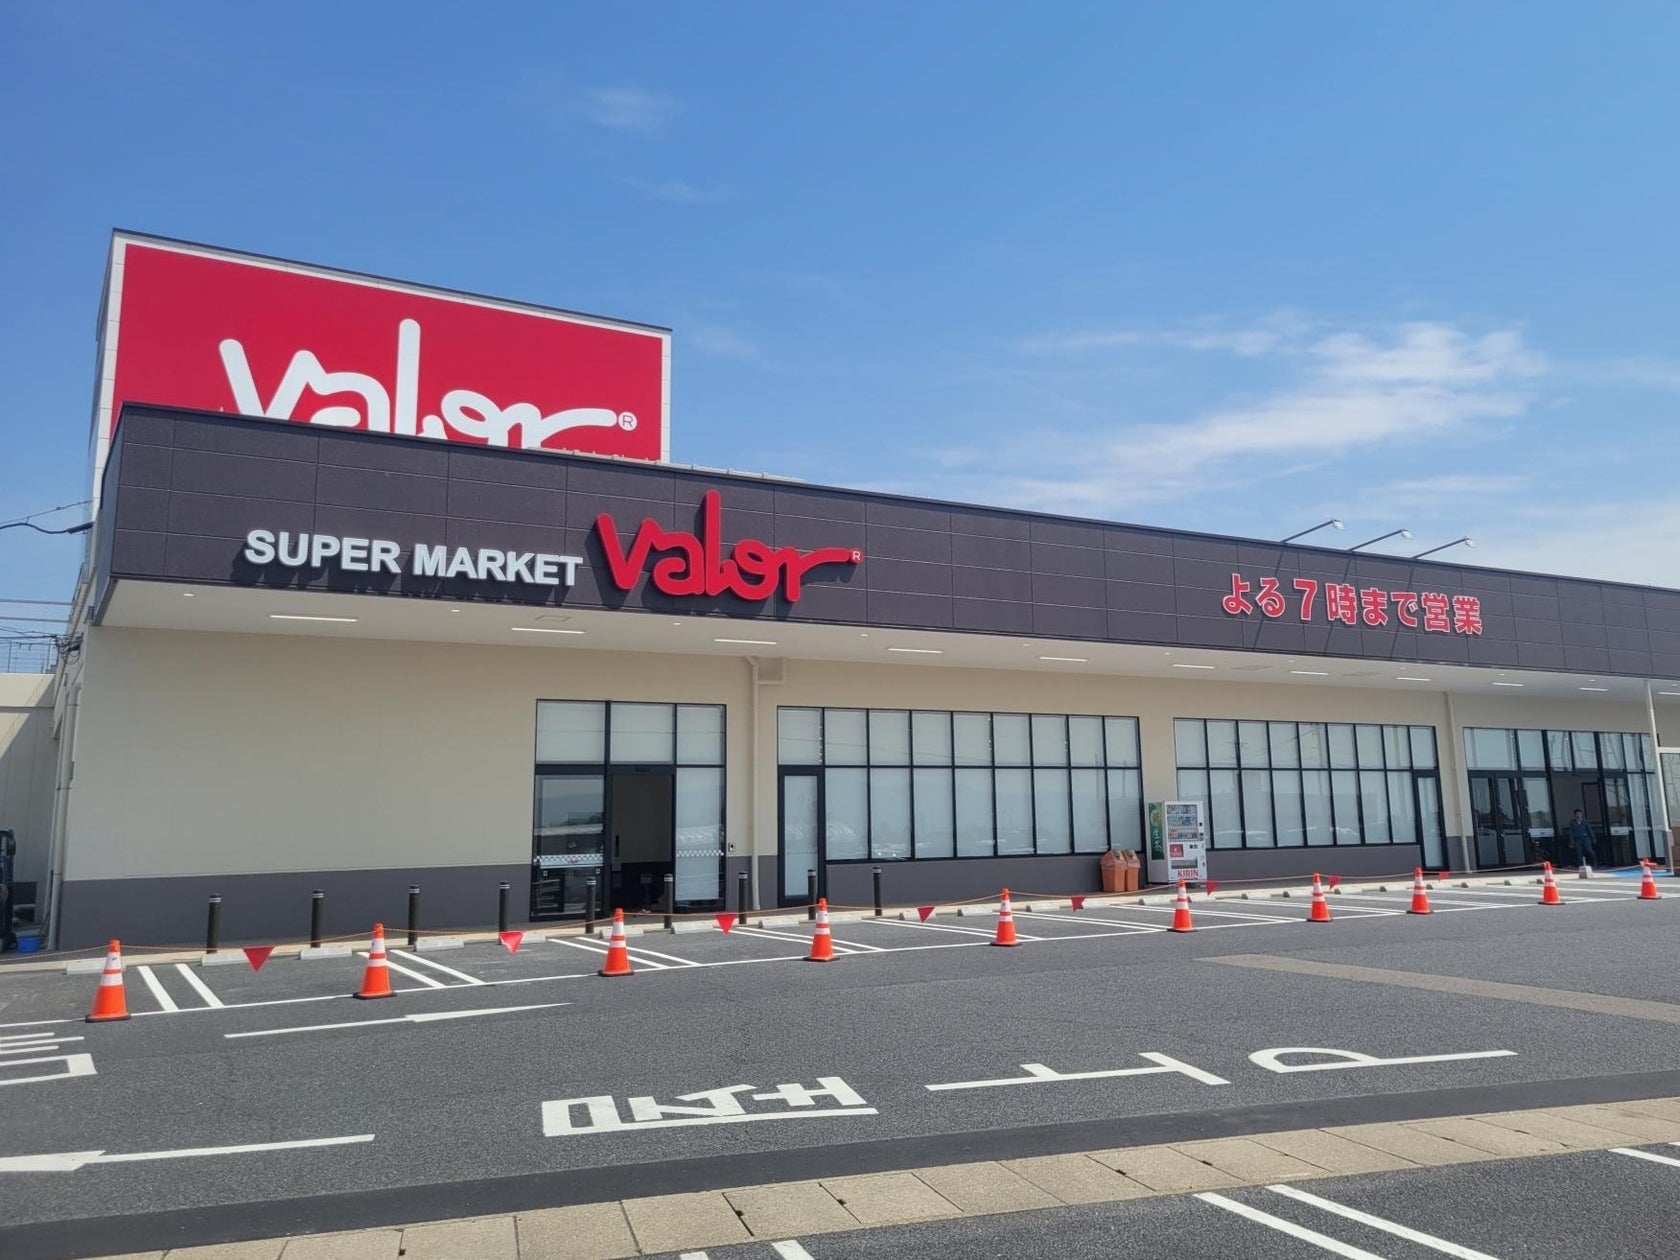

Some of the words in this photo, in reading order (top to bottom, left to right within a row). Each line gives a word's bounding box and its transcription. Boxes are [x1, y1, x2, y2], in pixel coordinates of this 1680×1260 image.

[244, 529, 402, 576] SUPER
[411, 543, 584, 587] MARKET
[1177, 869, 1199, 878] KIRIN
